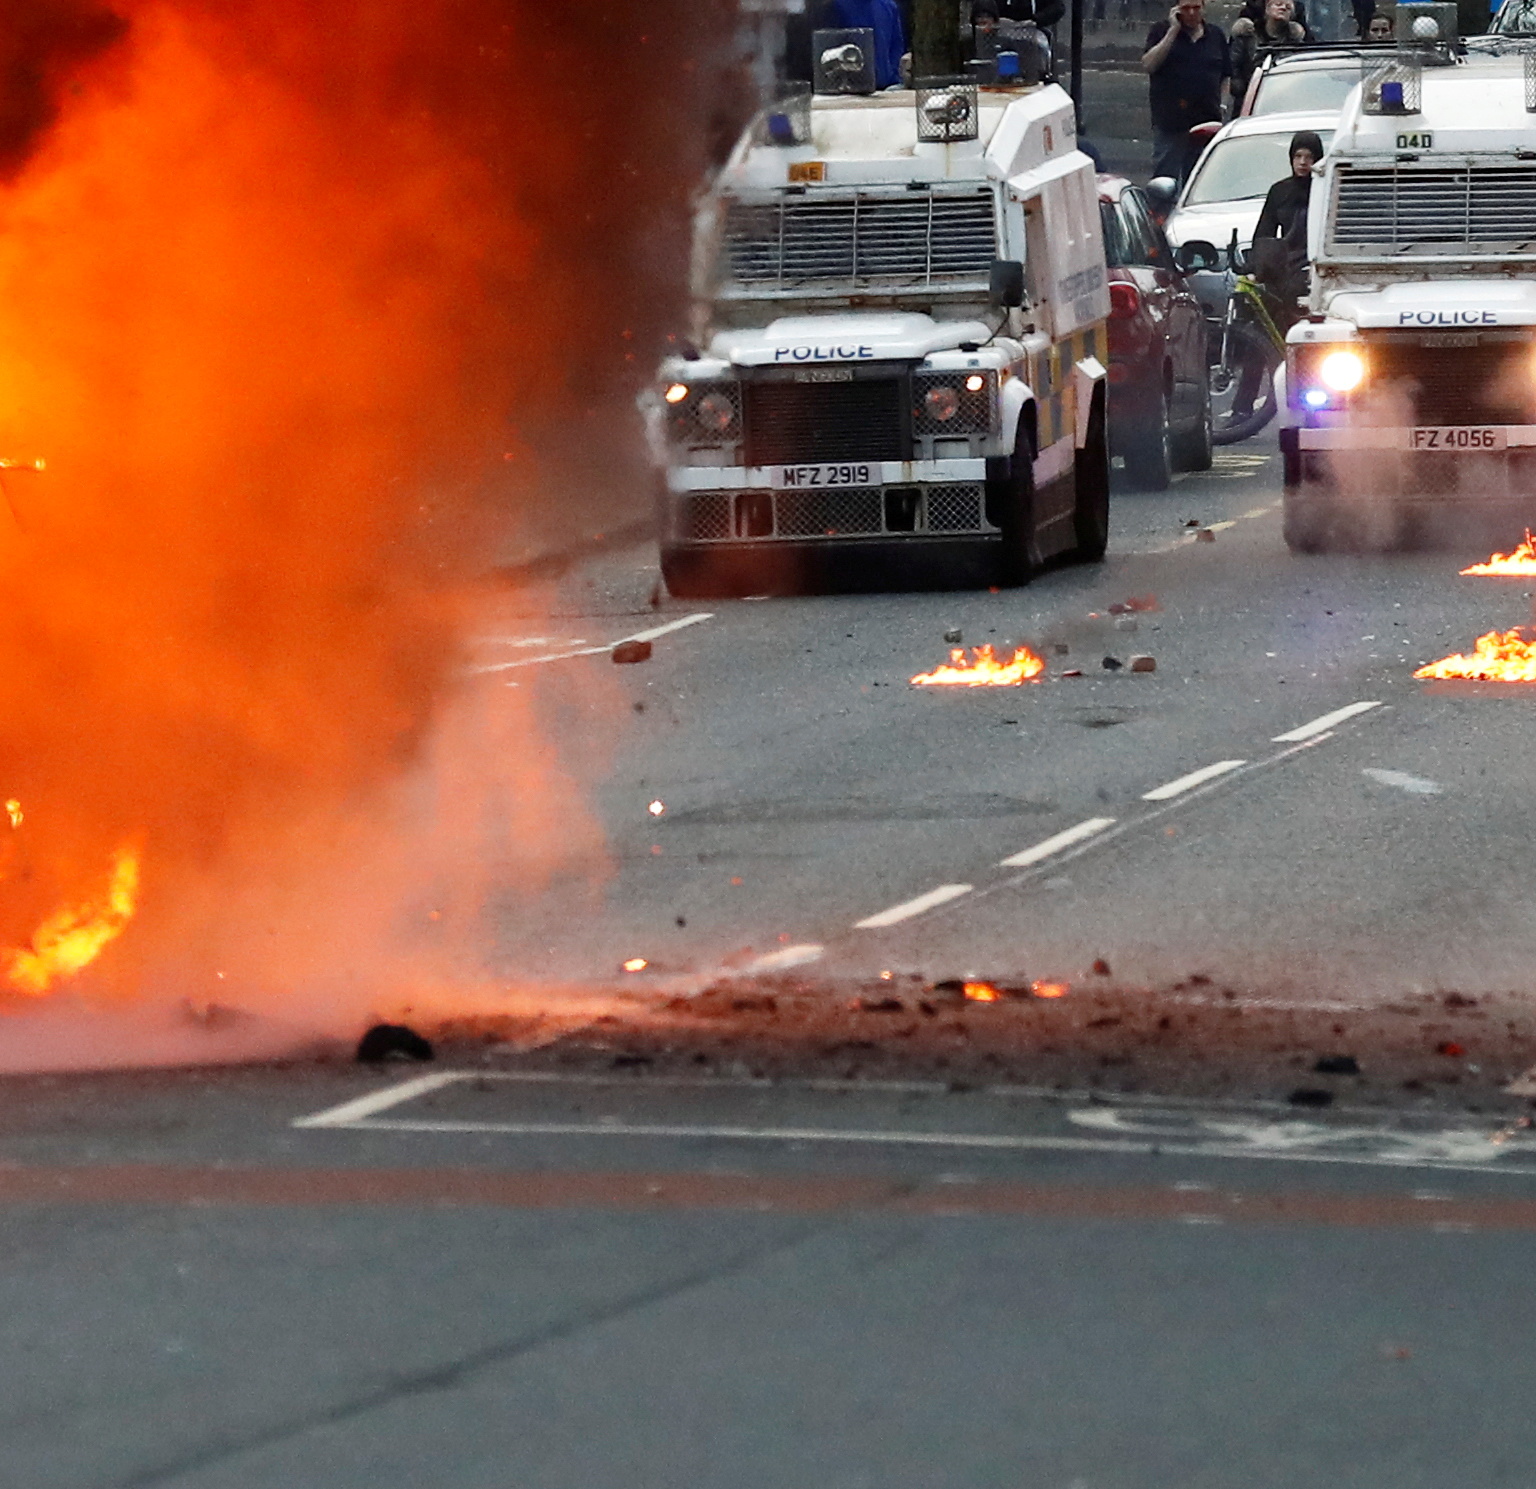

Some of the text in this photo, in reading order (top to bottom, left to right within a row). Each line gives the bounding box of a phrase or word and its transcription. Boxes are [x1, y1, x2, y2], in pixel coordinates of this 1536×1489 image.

[1399, 310, 1497, 325] POLICE
[774, 344, 874, 361] POLICE
[1445, 429, 1496, 448] 4056
[783, 465, 870, 486] MFZ 2919
